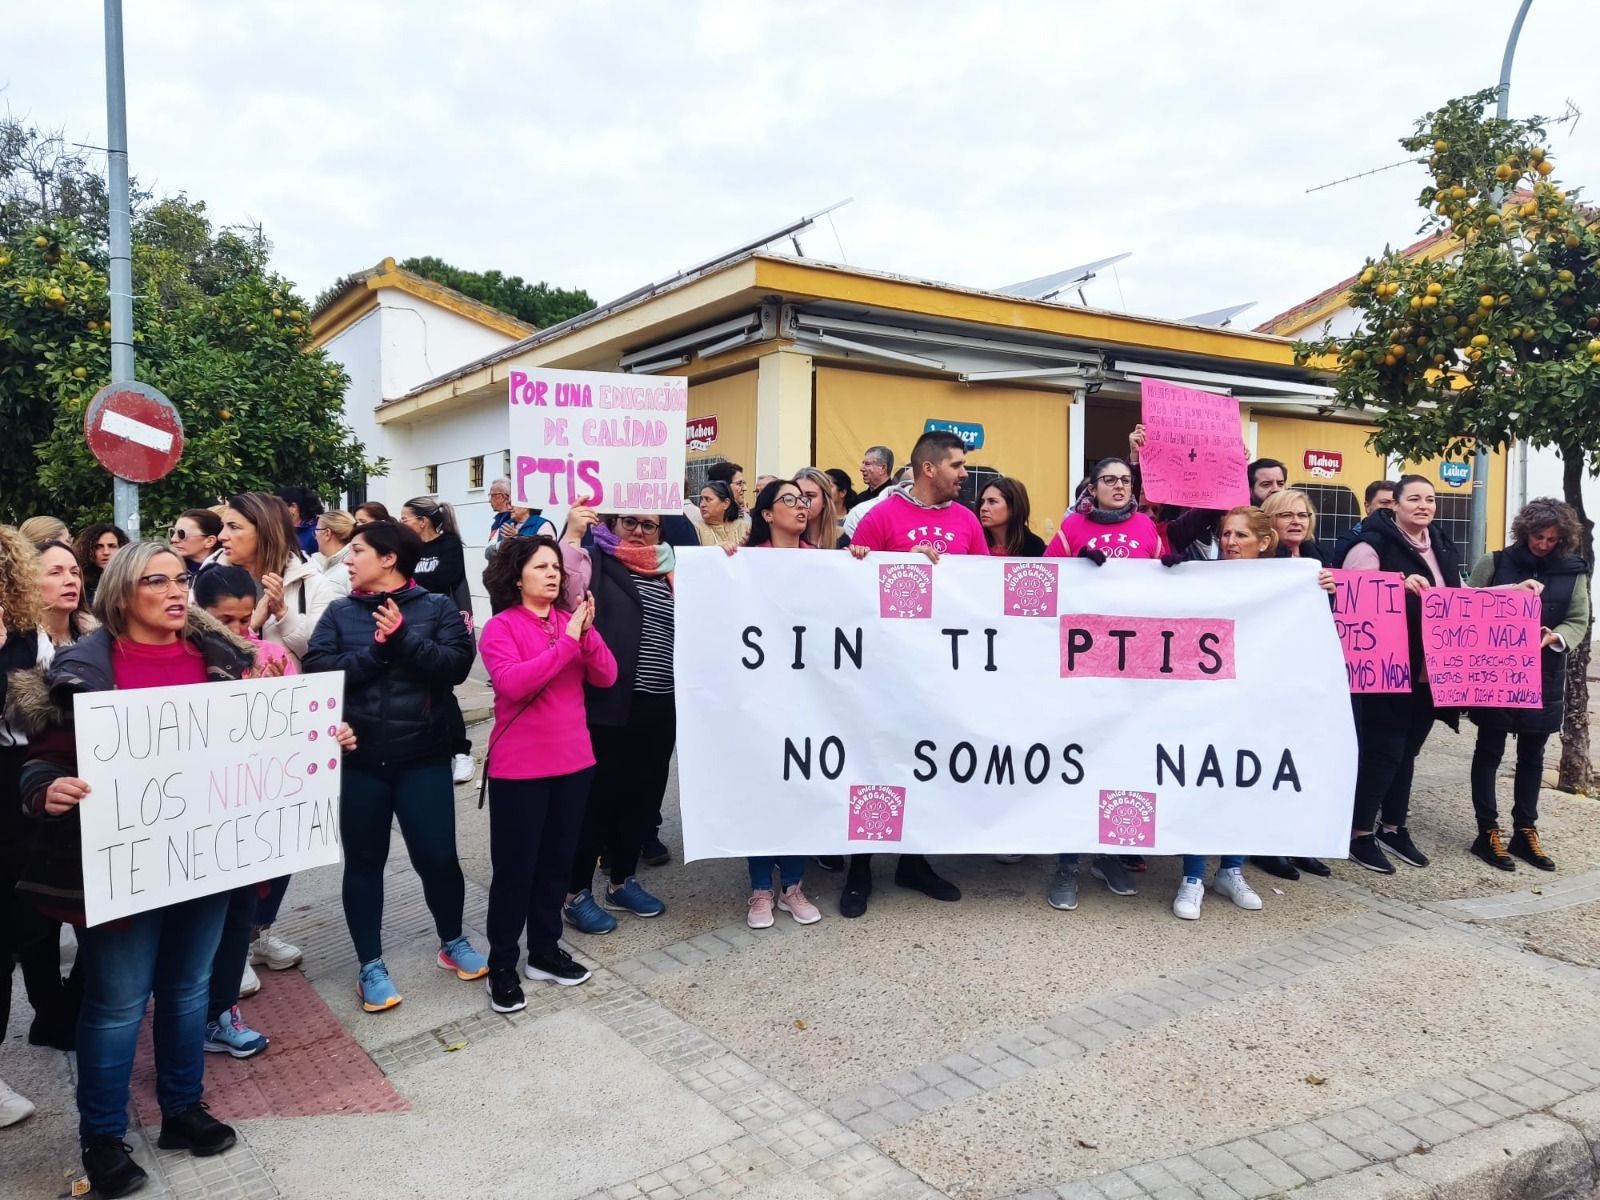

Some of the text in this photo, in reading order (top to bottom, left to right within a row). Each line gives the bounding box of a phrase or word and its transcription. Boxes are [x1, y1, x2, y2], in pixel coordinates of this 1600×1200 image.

[510, 371, 548, 406] POR
[555, 383, 592, 408] UNA
[543, 416, 668, 447] DE CALIDAD
[687, 423, 714, 440] Mahou
[636, 457, 667, 480] EN
[1308, 454, 1339, 468] Mahou
[516, 453, 604, 507] PTIS
[613, 482, 682, 509] LUCHA
[907, 526, 955, 541] PTIS
[1087, 533, 1140, 549] PTIS
[1331, 576, 1402, 615] IN TI
[1425, 592, 1454, 618] SIN
[1456, 596, 1472, 618] TI
[1523, 597, 1541, 619] NO
[889, 603, 923, 618] PTIS
[1013, 602, 1048, 616] PTIS
[1431, 624, 1528, 649] SOMOS NADA
[741, 625, 1224, 675] SIN TI PTIS
[1443, 655, 1463, 668] LOS
[1469, 654, 1517, 667] DERECHOS
[1521, 655, 1537, 667] DE
[1381, 652, 1411, 690] NADA
[1468, 670, 1498, 683] HIJOS
[1502, 669, 1528, 684] POR
[90, 679, 308, 762] JUAN JOSÉ
[782, 734, 1303, 793] NO SOMOS NADA
[114, 752, 304, 831] LOS NIÑOS
[856, 826, 893, 840] PTIS
[1107, 831, 1145, 846] PTIS
[97, 795, 340, 901] TE NECESITAN
